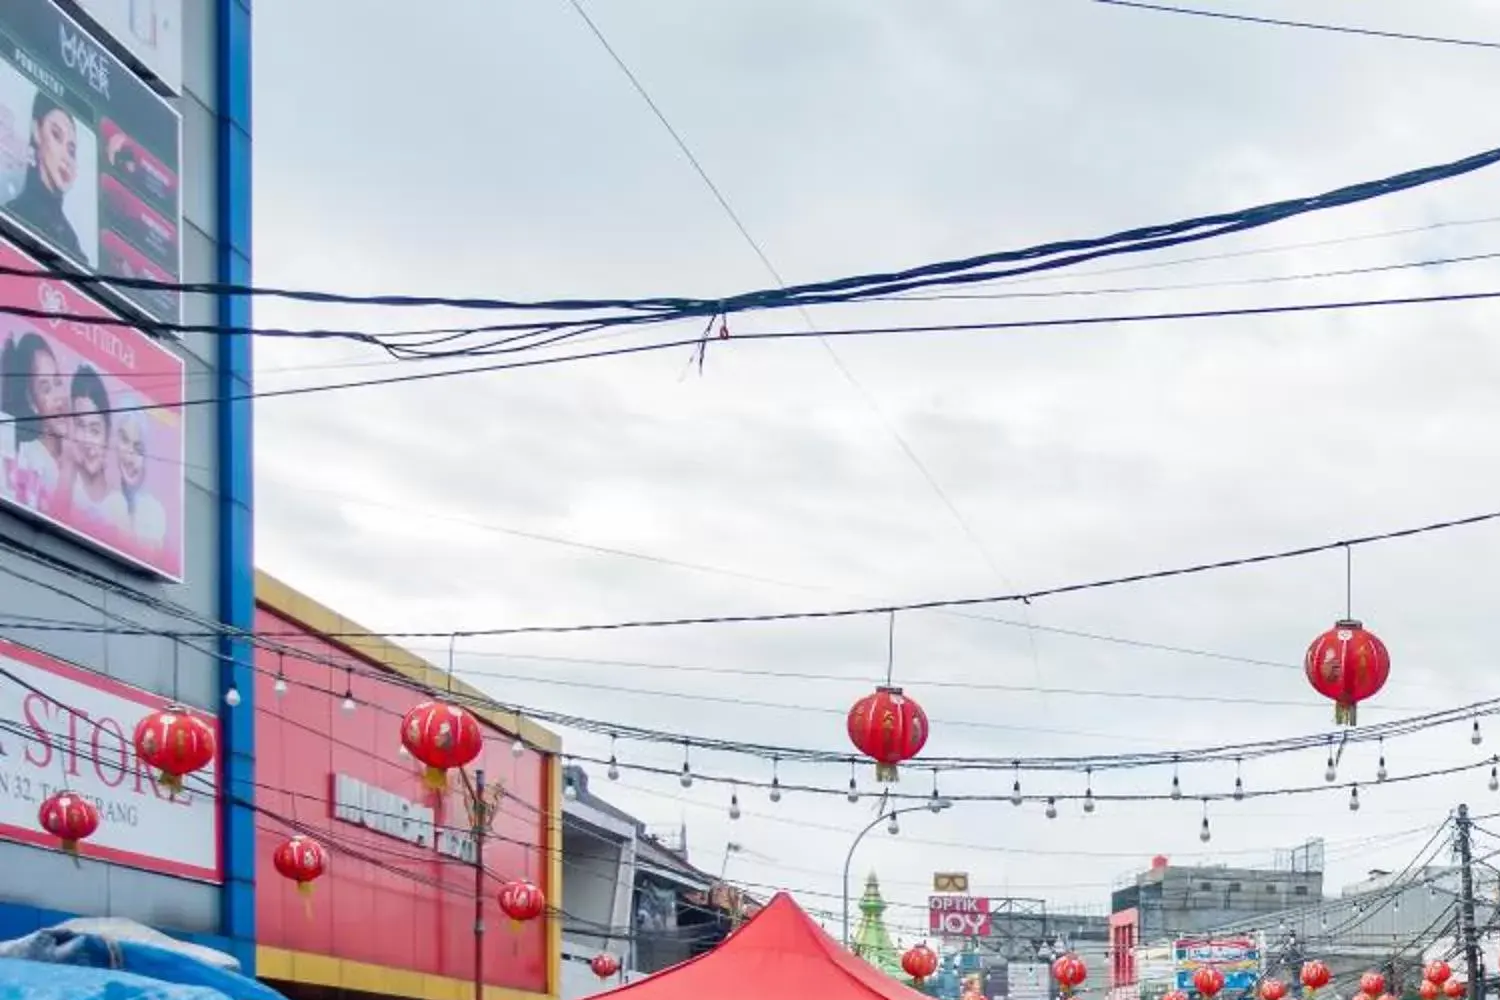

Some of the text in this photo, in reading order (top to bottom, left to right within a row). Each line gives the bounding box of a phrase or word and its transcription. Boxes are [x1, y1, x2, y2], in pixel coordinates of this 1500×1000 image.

[23, 691, 192, 807] STO
[931, 897, 977, 911] OPTIK
[931, 912, 986, 935] JOY
